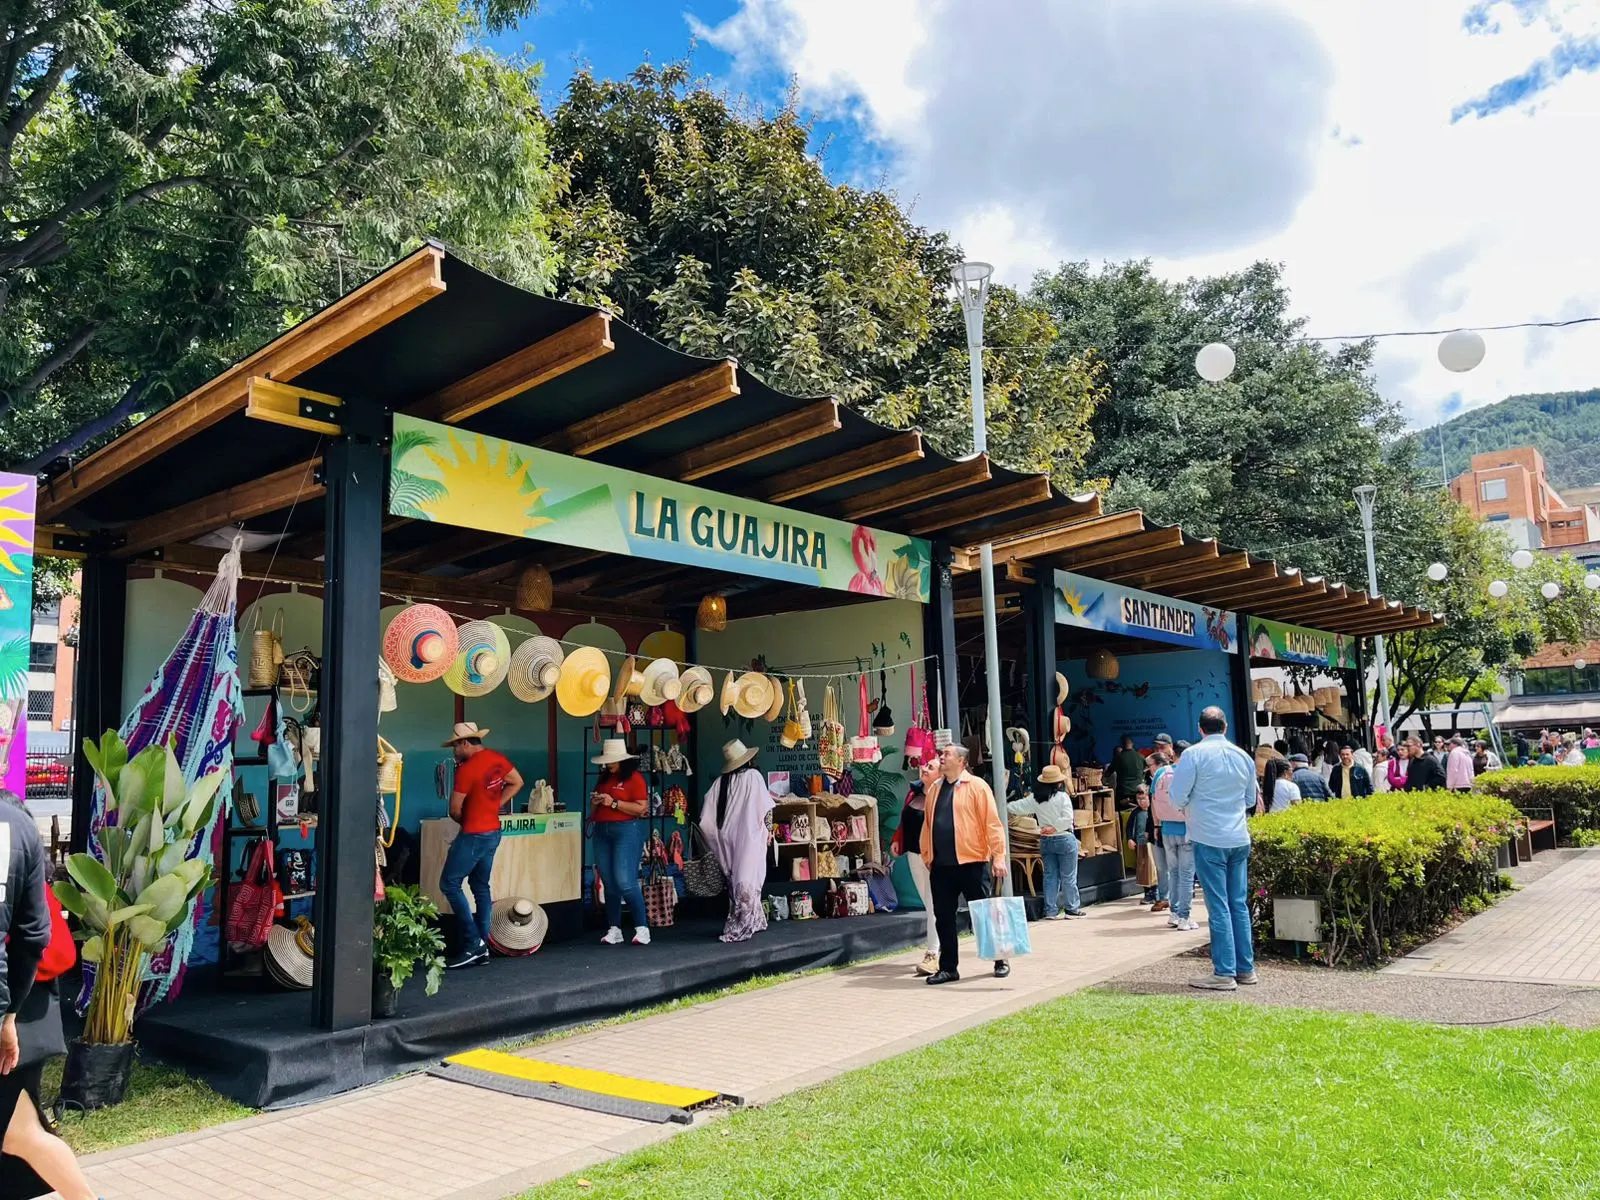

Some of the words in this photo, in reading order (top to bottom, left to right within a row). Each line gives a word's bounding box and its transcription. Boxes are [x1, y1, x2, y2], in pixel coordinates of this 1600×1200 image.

[635, 491, 679, 542] LA
[691, 505, 827, 569] GUAJIRA
[1124, 598, 1196, 635] SANTANDER
[1290, 632, 1328, 656] AMAZONAS
[500, 819, 536, 832] UAJIRA
